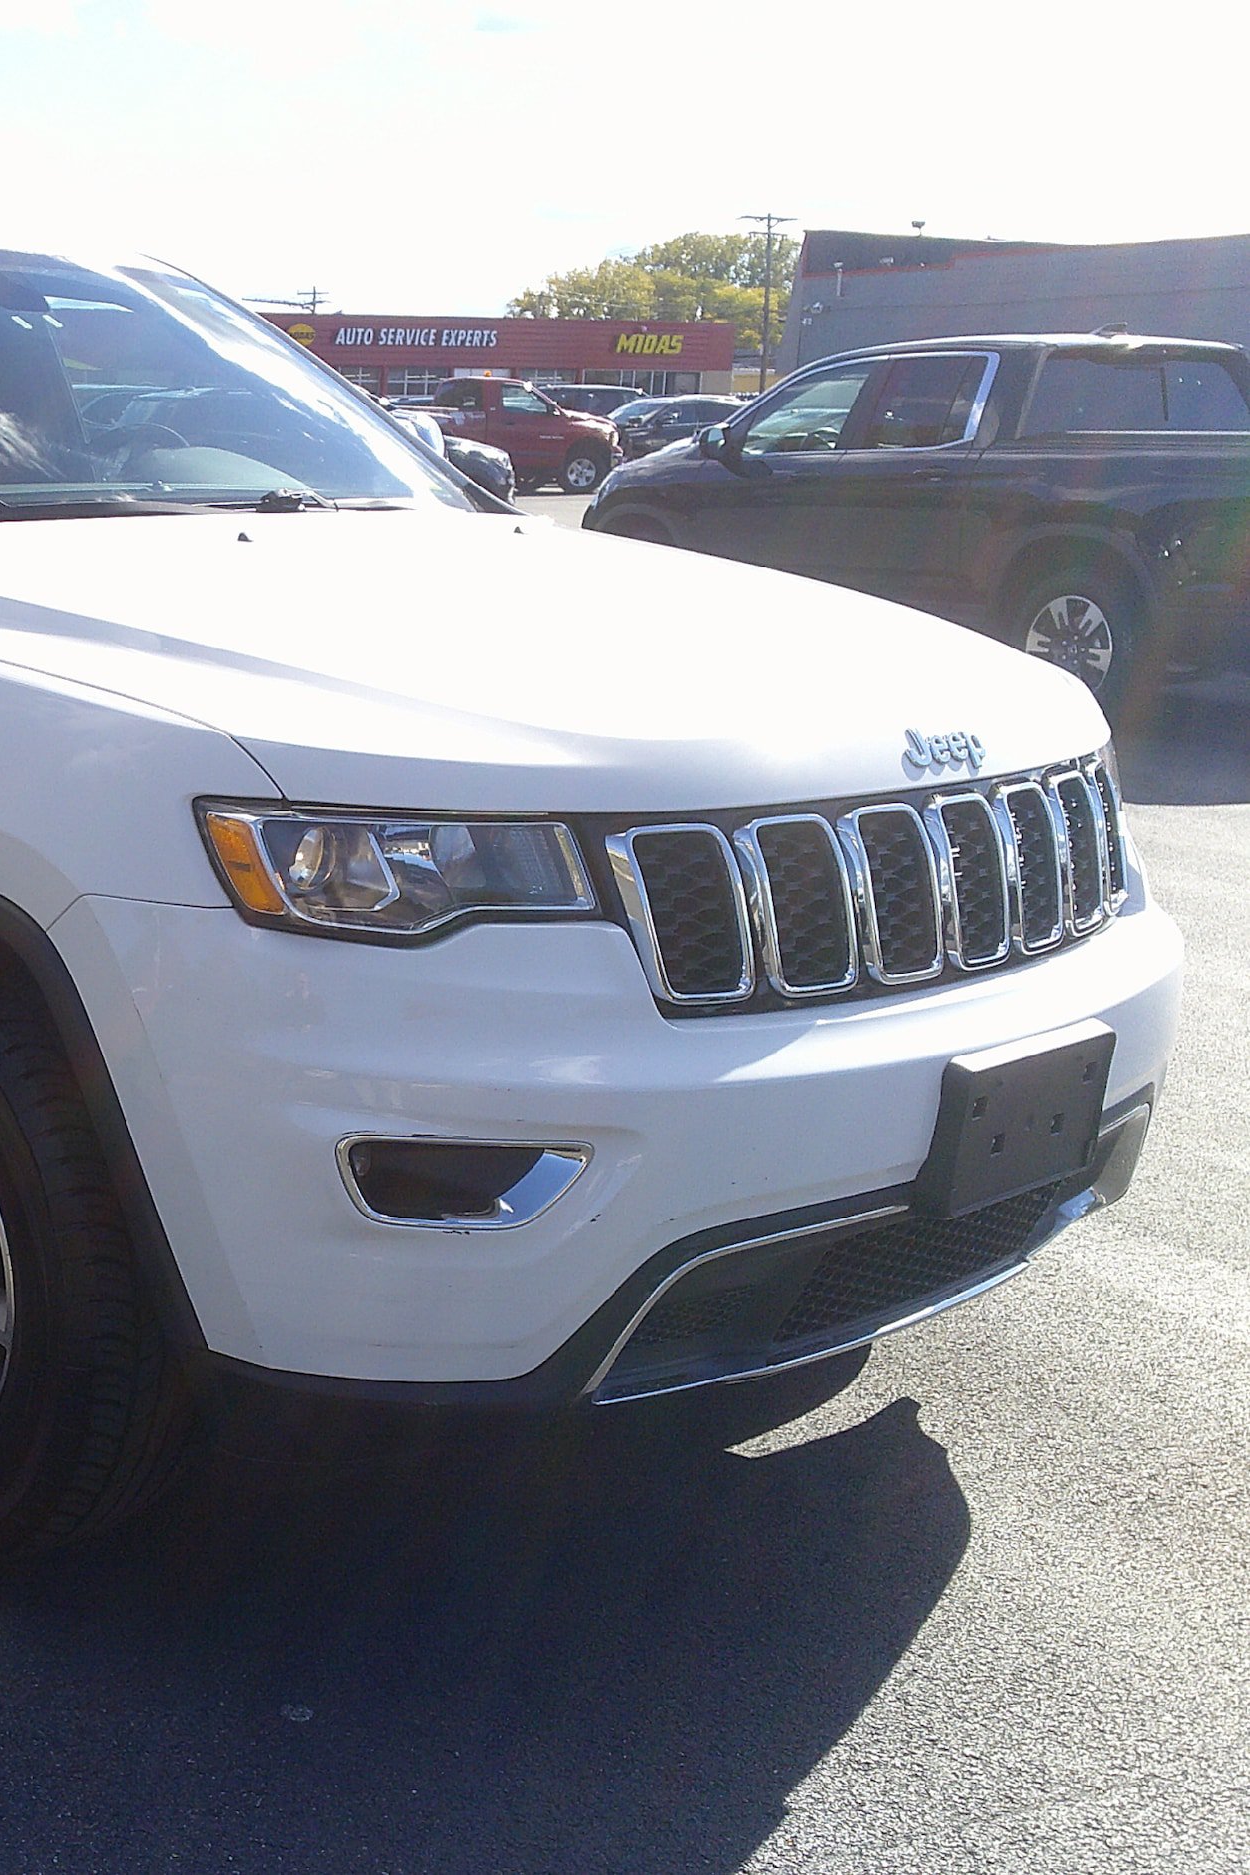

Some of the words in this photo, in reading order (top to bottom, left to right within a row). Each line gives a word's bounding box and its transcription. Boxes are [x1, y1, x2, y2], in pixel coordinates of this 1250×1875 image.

[335, 327, 374, 345] AUTO
[378, 328, 437, 346] SERVICE
[441, 329, 498, 347] EXPERTS
[615, 333, 685, 354] MIDAS
[903, 728, 986, 769] Jeep
